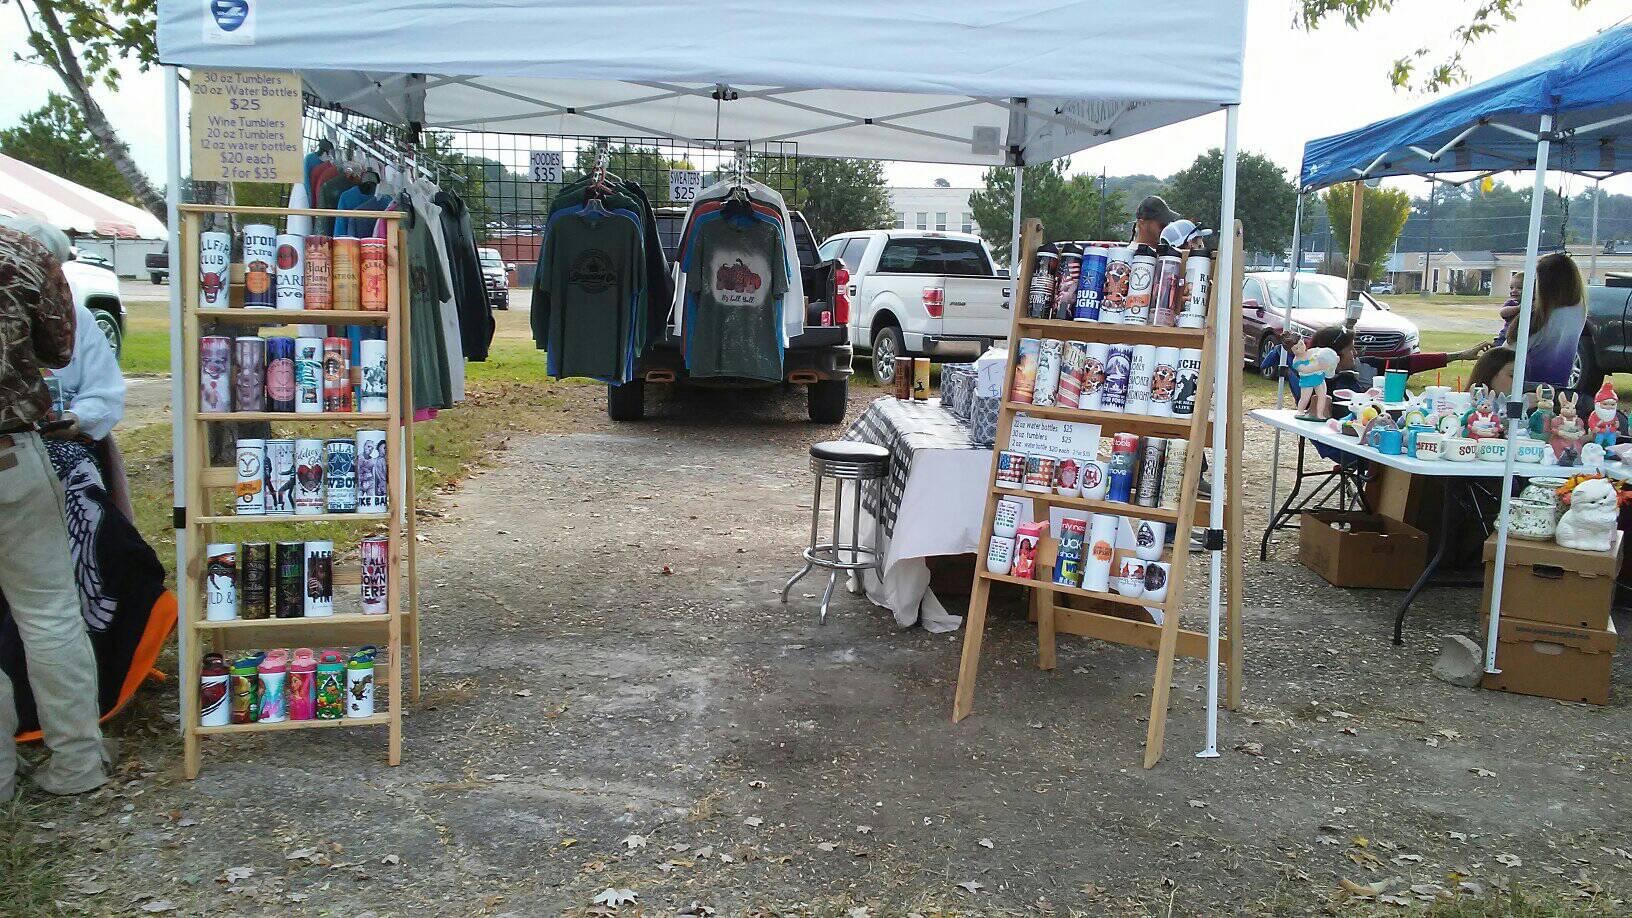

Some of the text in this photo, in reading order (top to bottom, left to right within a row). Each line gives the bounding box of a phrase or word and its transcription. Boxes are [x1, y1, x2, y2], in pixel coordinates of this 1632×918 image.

[204, 73, 282, 85] 30 oz Tumblers
[193, 84, 298, 98] 20 oz Water Bottles
[229, 98, 261, 111] $25
[208, 116, 285, 128] Wine Tumblers
[207, 128, 284, 140] 20 oz Tumblers
[212, 141, 225, 150] oz
[228, 141, 260, 151] water
[261, 140, 297, 152] bottles
[220, 152, 274, 165] $20 each
[530, 153, 560, 166] HOODIES
[222, 167, 277, 179] 2 for $35
[534, 167, 556, 182] $35
[670, 170, 700, 185] SWEATERS
[674, 186, 695, 200] $25
[246, 247, 273, 257] Extra
[1077, 289, 1098, 300] BUD
[1076, 299, 1100, 309] IGHT
[1026, 422, 1040, 430] water
[1416, 442, 1438, 453] OFFEE
[1459, 445, 1476, 456] SOU
[1480, 445, 1505, 456] SOUP
[1519, 446, 1544, 457] SOUP
[369, 557, 386, 566] ALL
[362, 575, 386, 585] OWN
